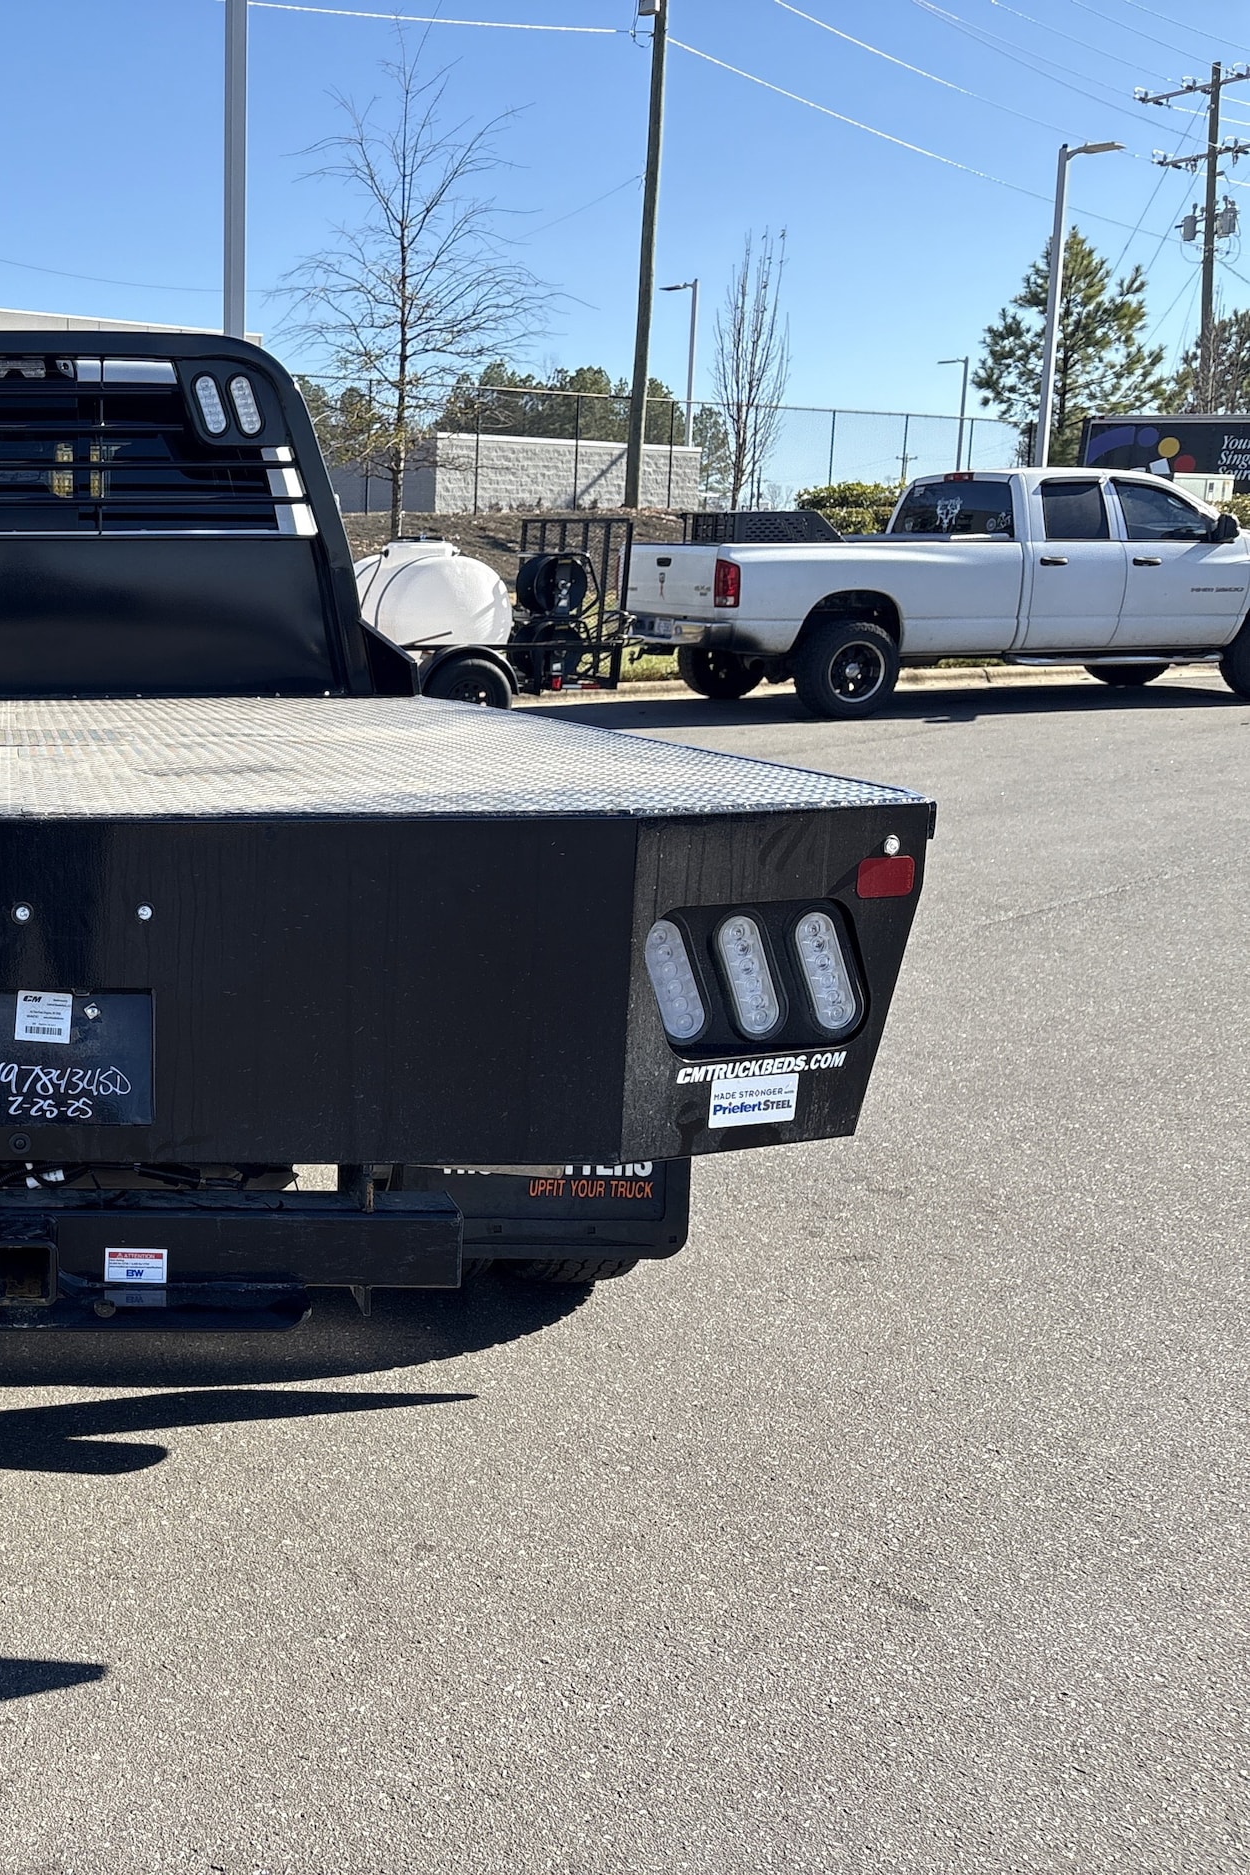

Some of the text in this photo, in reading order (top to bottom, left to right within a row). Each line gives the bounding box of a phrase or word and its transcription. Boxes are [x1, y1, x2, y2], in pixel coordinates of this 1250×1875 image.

[1218, 450, 1250, 469] Sing
[676, 1050, 848, 1085] CMTRUCKBEDS.COM
[713, 1091, 737, 1101] MADE
[738, 1087, 784, 1099] STRONGER
[529, 1179, 654, 1198] UPFIT YOUR TRUCK
